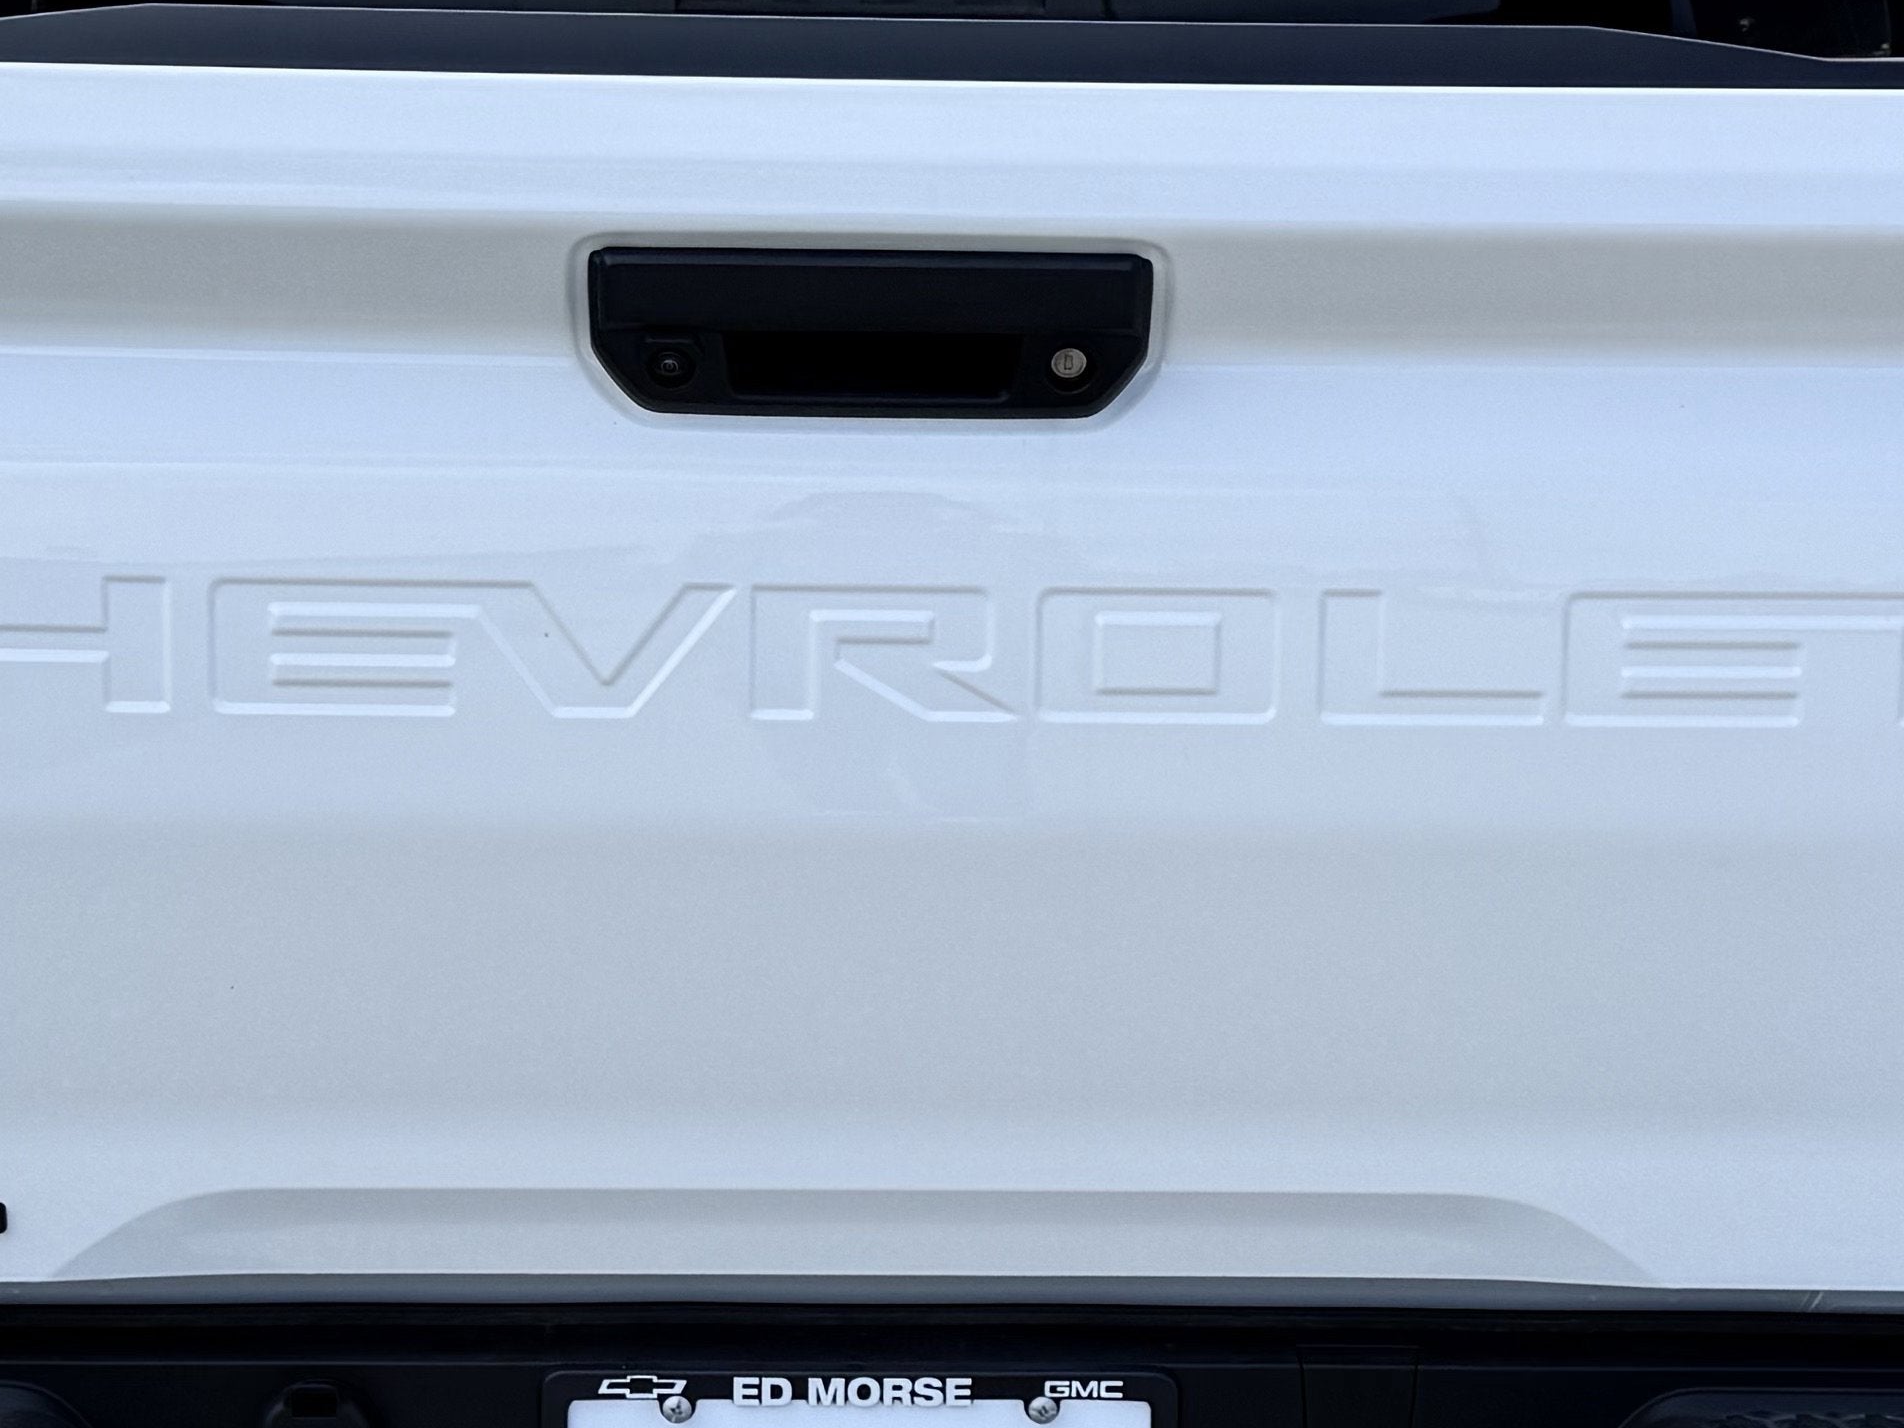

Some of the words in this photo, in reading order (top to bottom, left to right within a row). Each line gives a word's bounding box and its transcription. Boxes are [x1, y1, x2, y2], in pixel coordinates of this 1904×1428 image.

[732, 1376, 793, 1407] ED
[807, 1376, 972, 1407] MORSE
[1044, 1380, 1124, 1399] GMC
